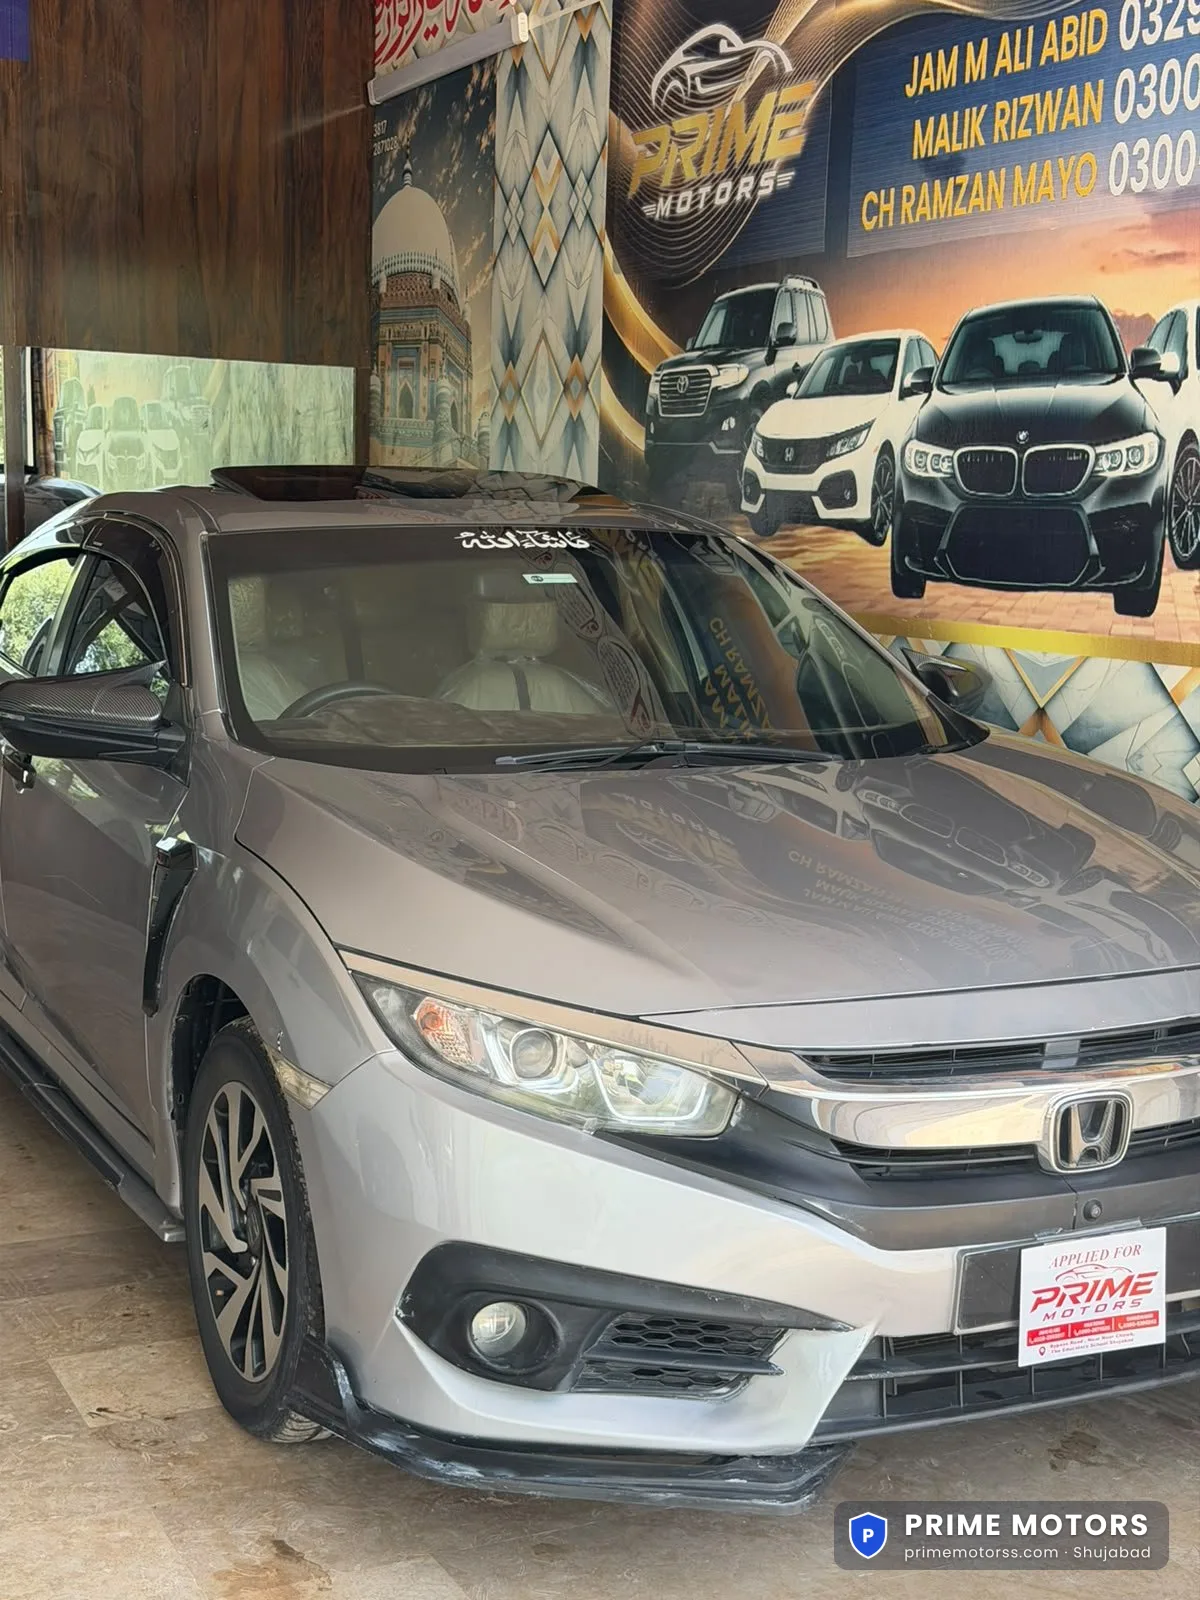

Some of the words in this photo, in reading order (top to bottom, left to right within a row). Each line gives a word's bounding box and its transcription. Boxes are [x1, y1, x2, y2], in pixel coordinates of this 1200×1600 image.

[904, 45, 960, 98] JAM
[964, 37, 989, 85] M
[993, 25, 1034, 78] ALI
[1039, 8, 1109, 67] ABID
[627, 79, 818, 200] PRIME
[912, 103, 988, 160] MALIK
[993, 79, 1104, 144] RIZWAN
[655, 170, 777, 220] MOTORS
[861, 187, 896, 231] CH
[900, 167, 1006, 225] RAMZAN
[1012, 151, 1098, 208] MAYO
[1049, 1251, 1110, 1269] APPLIED
[1114, 1244, 1142, 1258] FOR
[1030, 1271, 1159, 1313] PRIME
[1042, 1298, 1143, 1322] MOTORS
